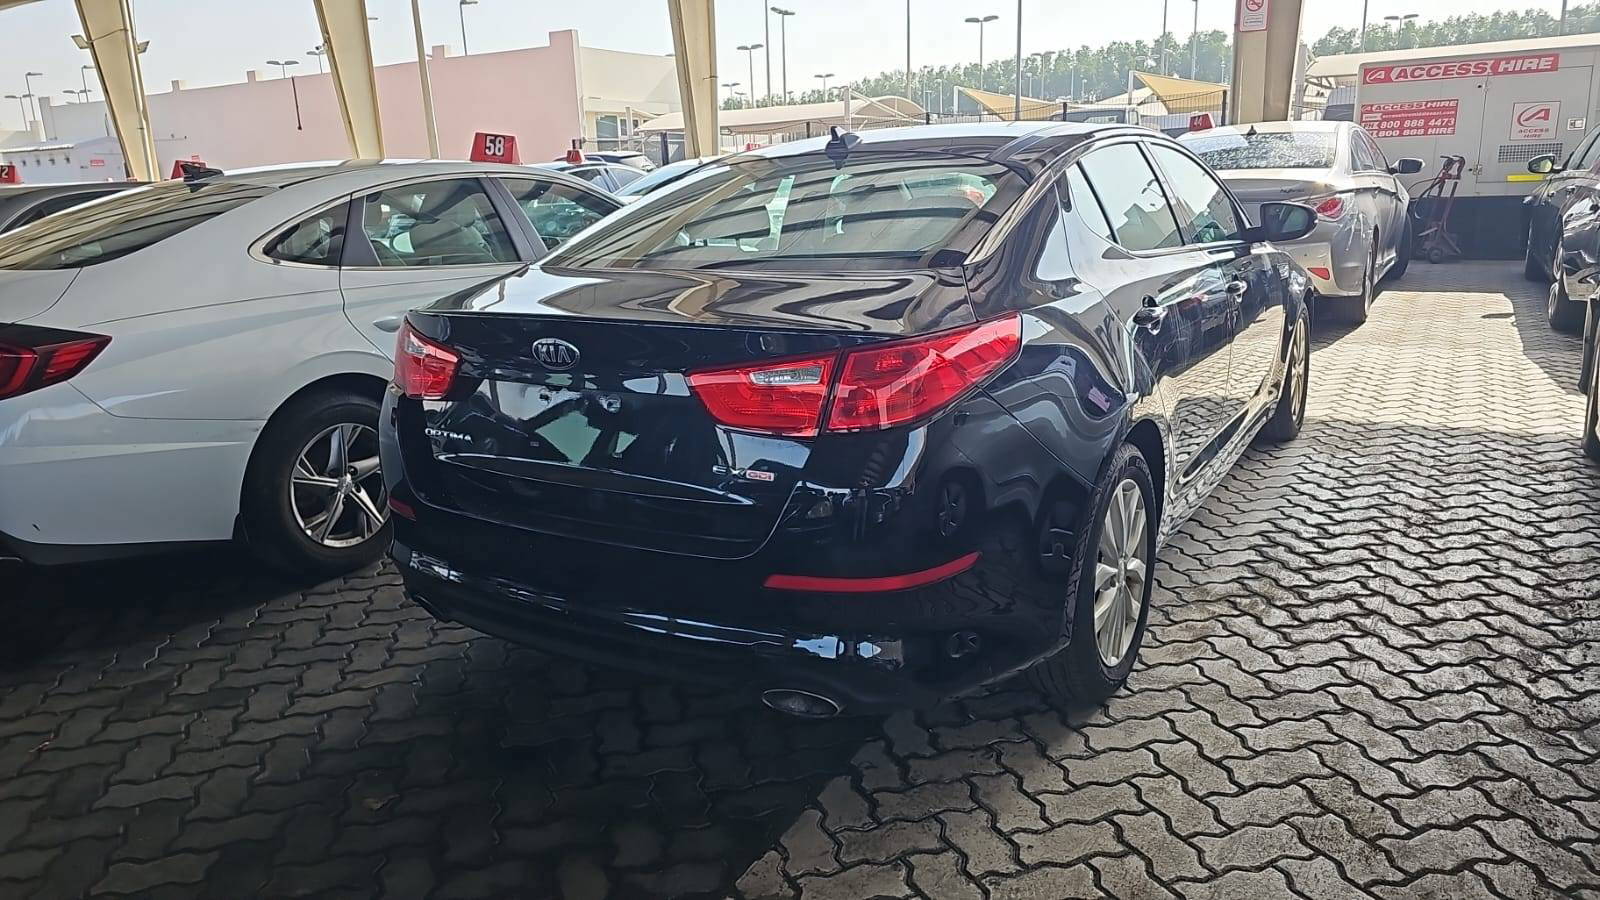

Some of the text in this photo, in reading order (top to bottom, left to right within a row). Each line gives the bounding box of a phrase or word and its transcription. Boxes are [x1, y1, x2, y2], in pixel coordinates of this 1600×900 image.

[1395, 62, 1489, 80] ACCESS
[1498, 56, 1554, 73] HIRE
[1403, 119, 1425, 127] 888
[1428, 118, 1455, 127] 4473
[1427, 127, 1455, 135] HIRE
[485, 135, 505, 156] 58
[0, 166, 9, 178] 2
[537, 344, 571, 363] KIA
[424, 428, 473, 443] OPTIMA
[712, 465, 746, 478] EX
